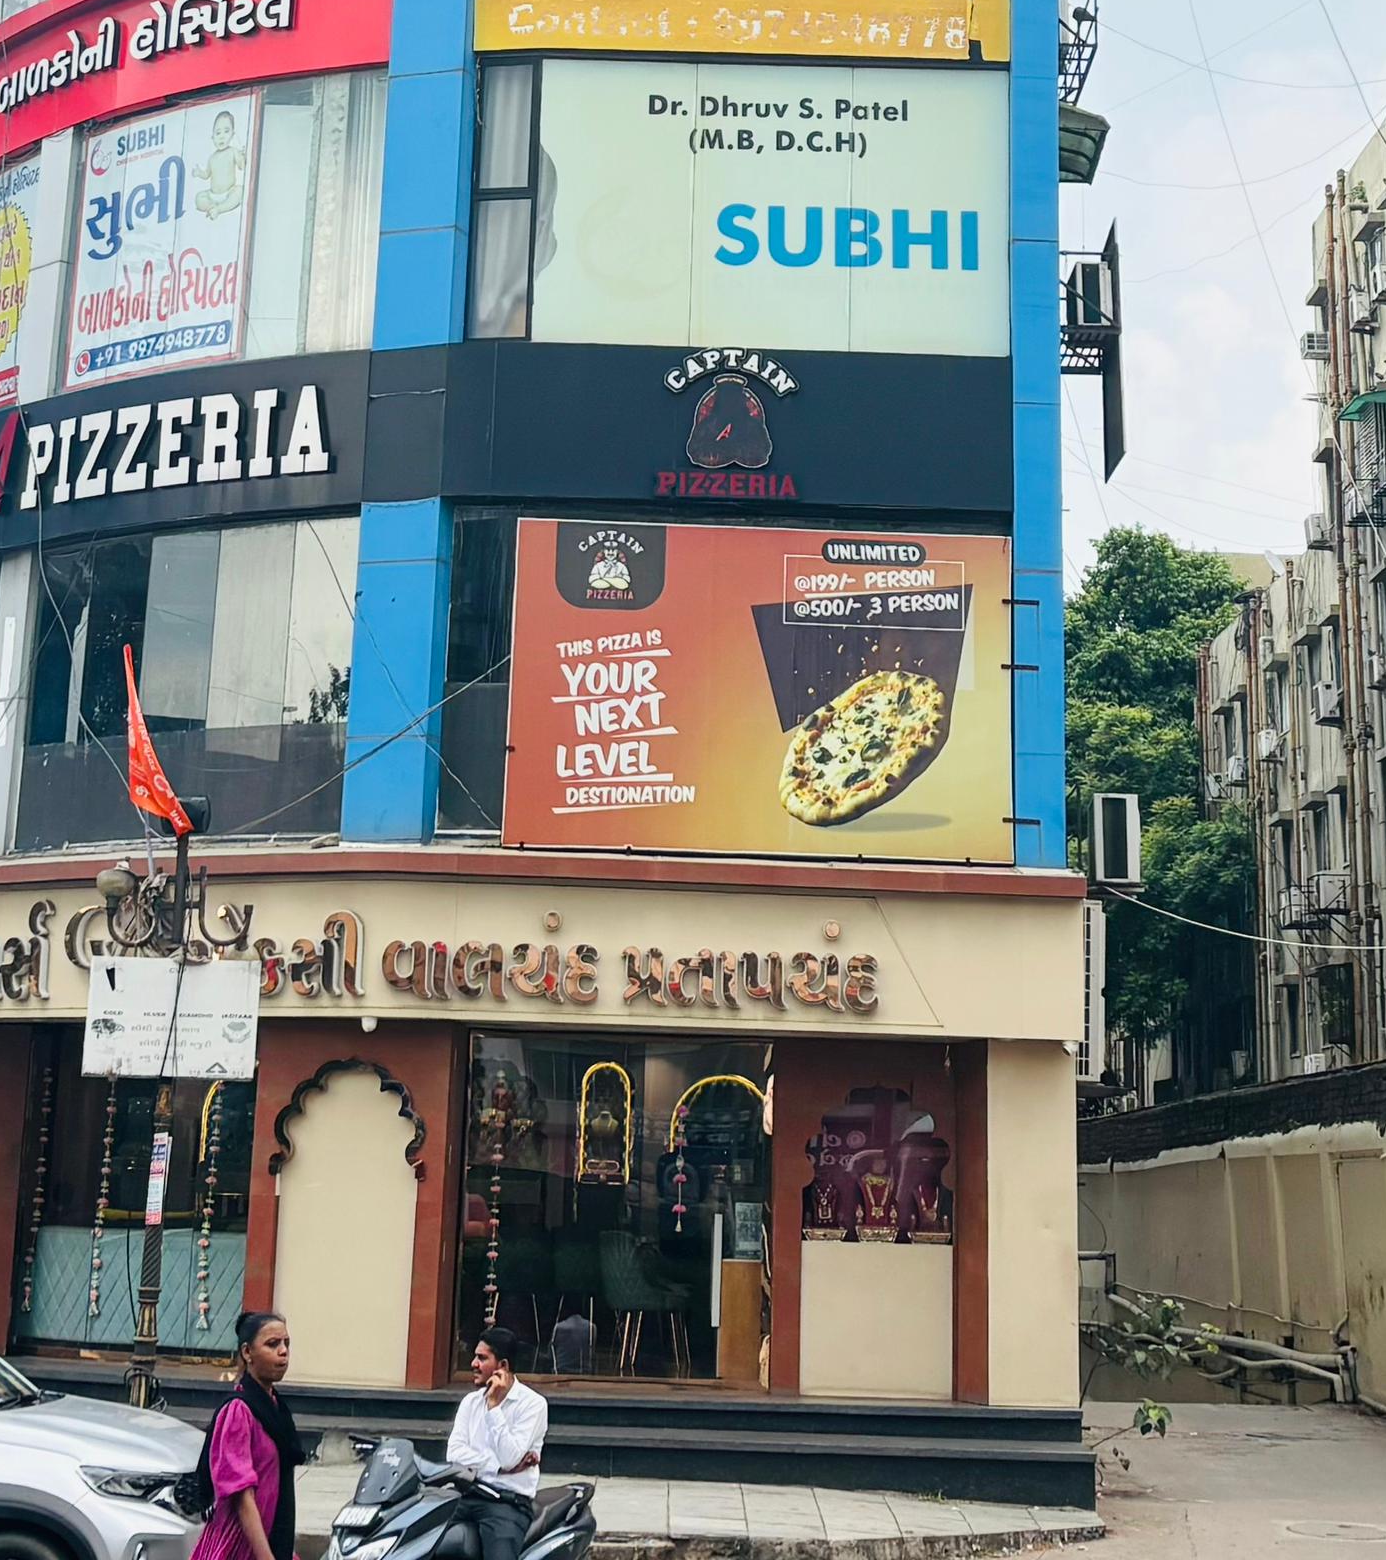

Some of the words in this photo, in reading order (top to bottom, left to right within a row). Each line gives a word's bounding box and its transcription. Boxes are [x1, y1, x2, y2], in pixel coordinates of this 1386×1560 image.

[648, 94, 689, 117] Dr.
[699, 95, 788, 120] Dhruv
[798, 97, 822, 120] S.
[835, 98, 909, 123] Patel
[116, 124, 165, 157] SUBHI
[688, 128, 765, 155] (M.B,
[775, 129, 868, 159] D.C.H)
[86, 155, 186, 261] સુભી
[714, 203, 979, 271] SUBHI
[94, 342, 121, 367] +91
[663, 346, 799, 396] CAPTAIN
[19, 385, 330, 510] PIZZERIA
[654, 471, 797, 499] PIZZERIA
[578, 530, 645, 555] CAPTAIN
[827, 544, 921, 563] UNLIMITED
[586, 588, 635, 601] PIZZERIA
[864, 569, 935, 589] PERSON
[869, 596, 883, 616] 3
[888, 593, 959, 613] PERSON
[556, 640, 594, 659] THIS
[596, 632, 644, 654] PIZZA
[645, 629, 662, 646] IS
[560, 661, 659, 697] YOUR
[574, 694, 662, 737] NEXT
[555, 741, 657, 779] LEVEL
[381, 910, 603, 1006] વાલચંદ
[621, 918, 881, 1014] પ્રતાપચંદ
